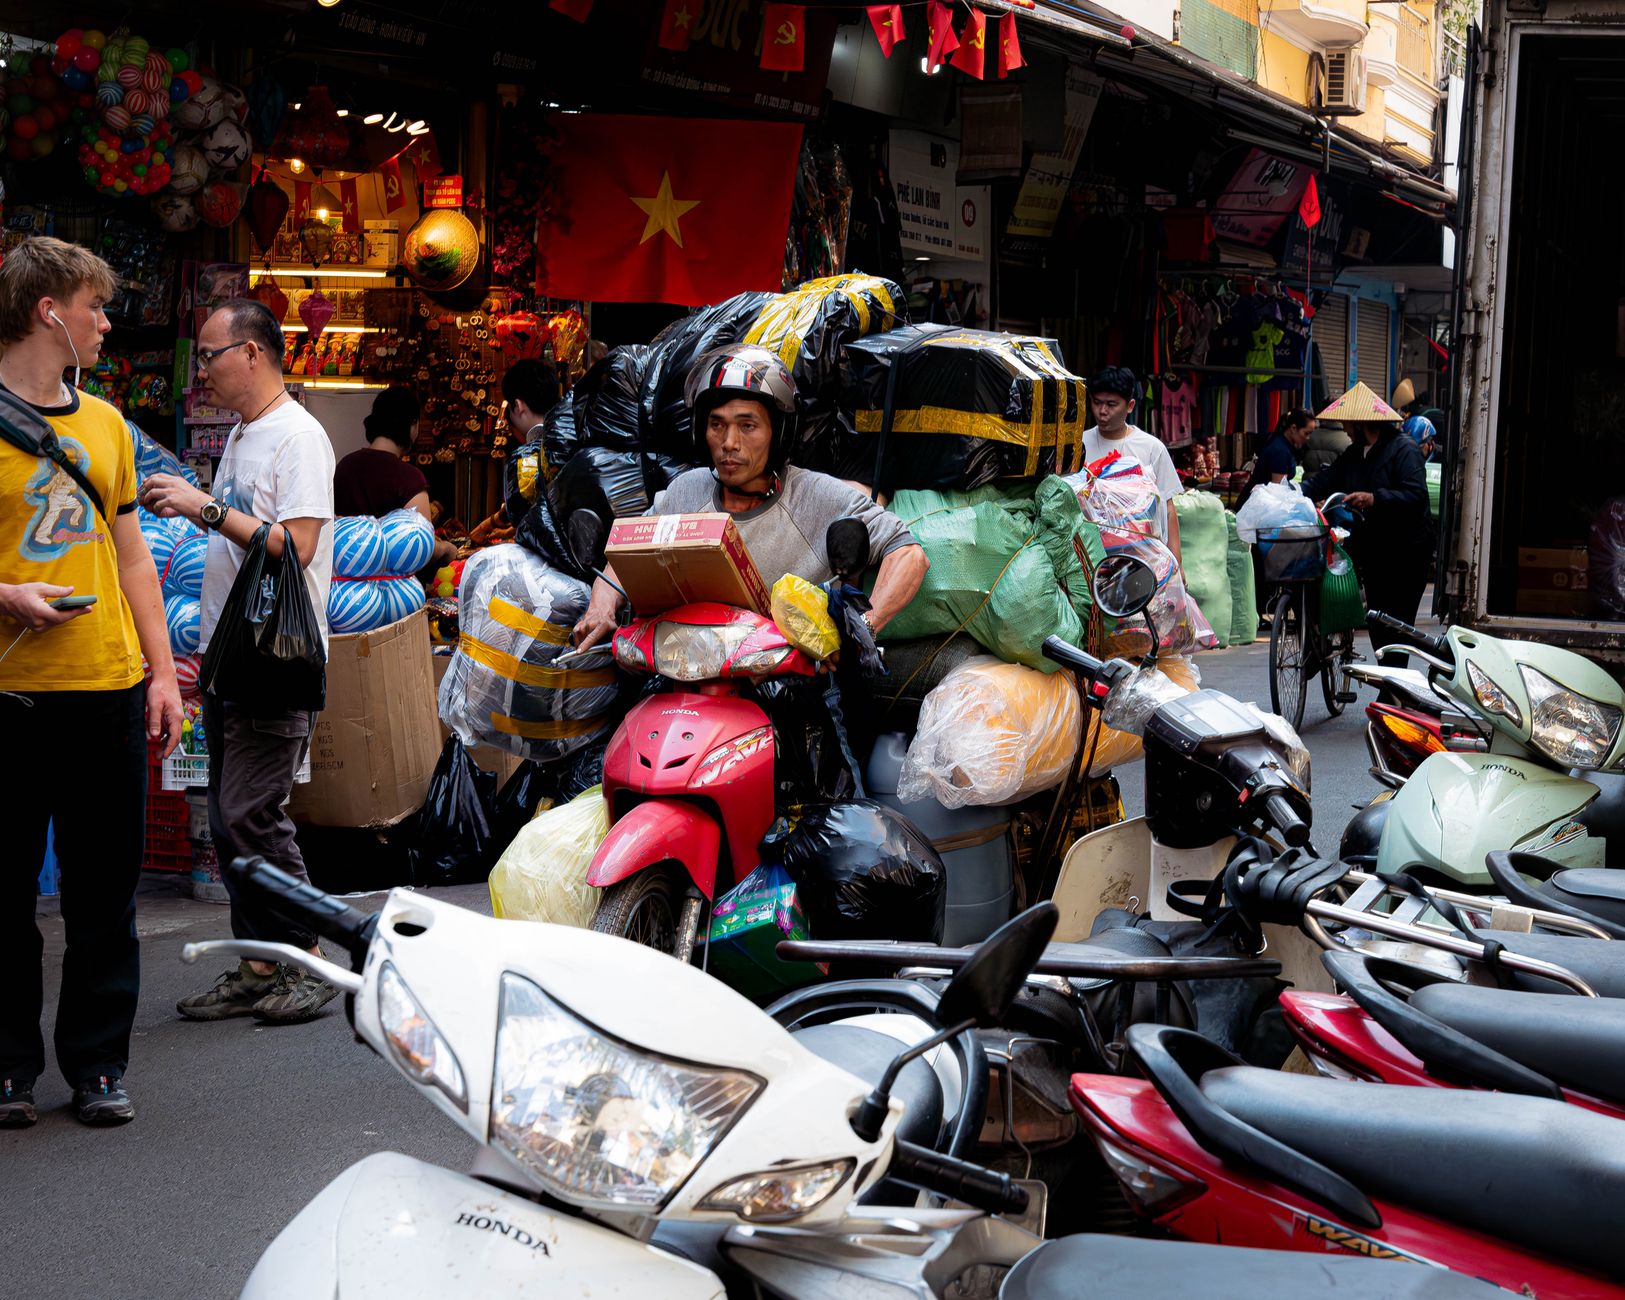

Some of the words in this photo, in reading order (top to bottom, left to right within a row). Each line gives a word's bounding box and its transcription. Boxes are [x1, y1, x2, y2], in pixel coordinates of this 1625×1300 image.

[688, 733, 773, 788] WAVE
[1481, 763, 1527, 781] HONDA
[456, 1213, 551, 1258] HONDA
[1309, 1218, 1400, 1260] WAV
